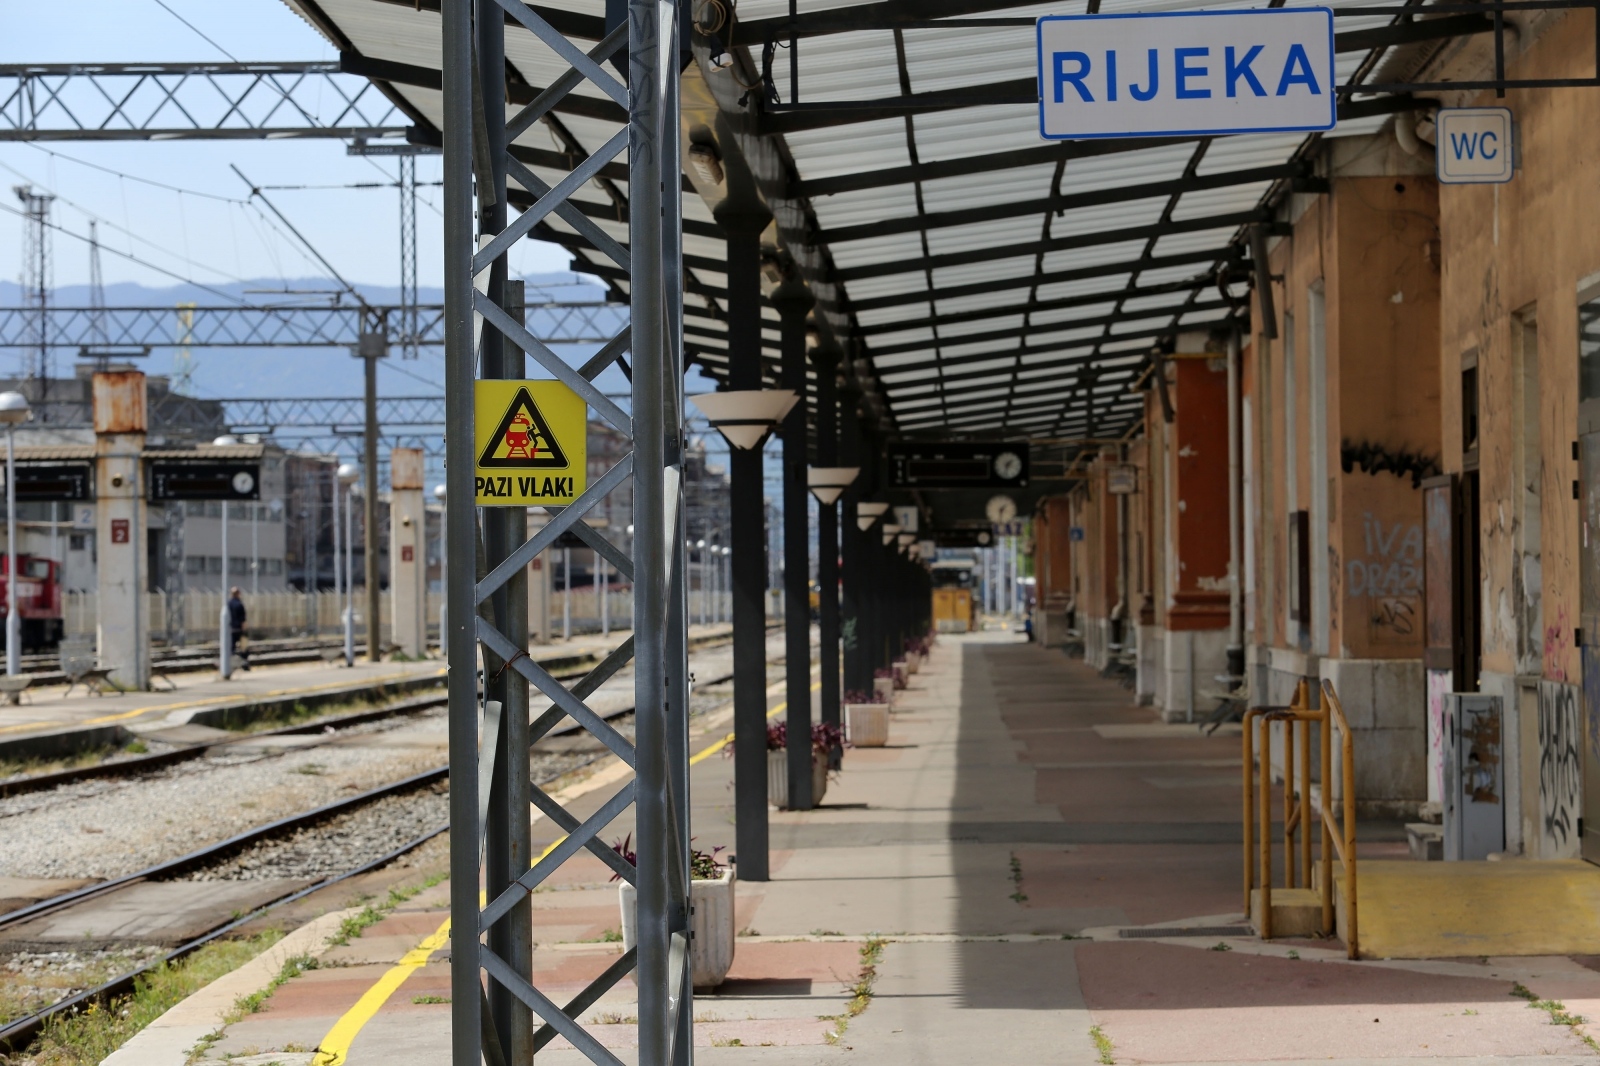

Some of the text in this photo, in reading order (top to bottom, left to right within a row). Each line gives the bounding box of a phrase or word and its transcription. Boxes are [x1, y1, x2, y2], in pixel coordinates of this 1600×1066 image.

[1052, 43, 1322, 104] RIJEKA
[1450, 131, 1498, 161] WC
[474, 477, 574, 497] PAZI VLAK!
[81, 508, 93, 524] 2
[116, 528, 126, 542] 2
